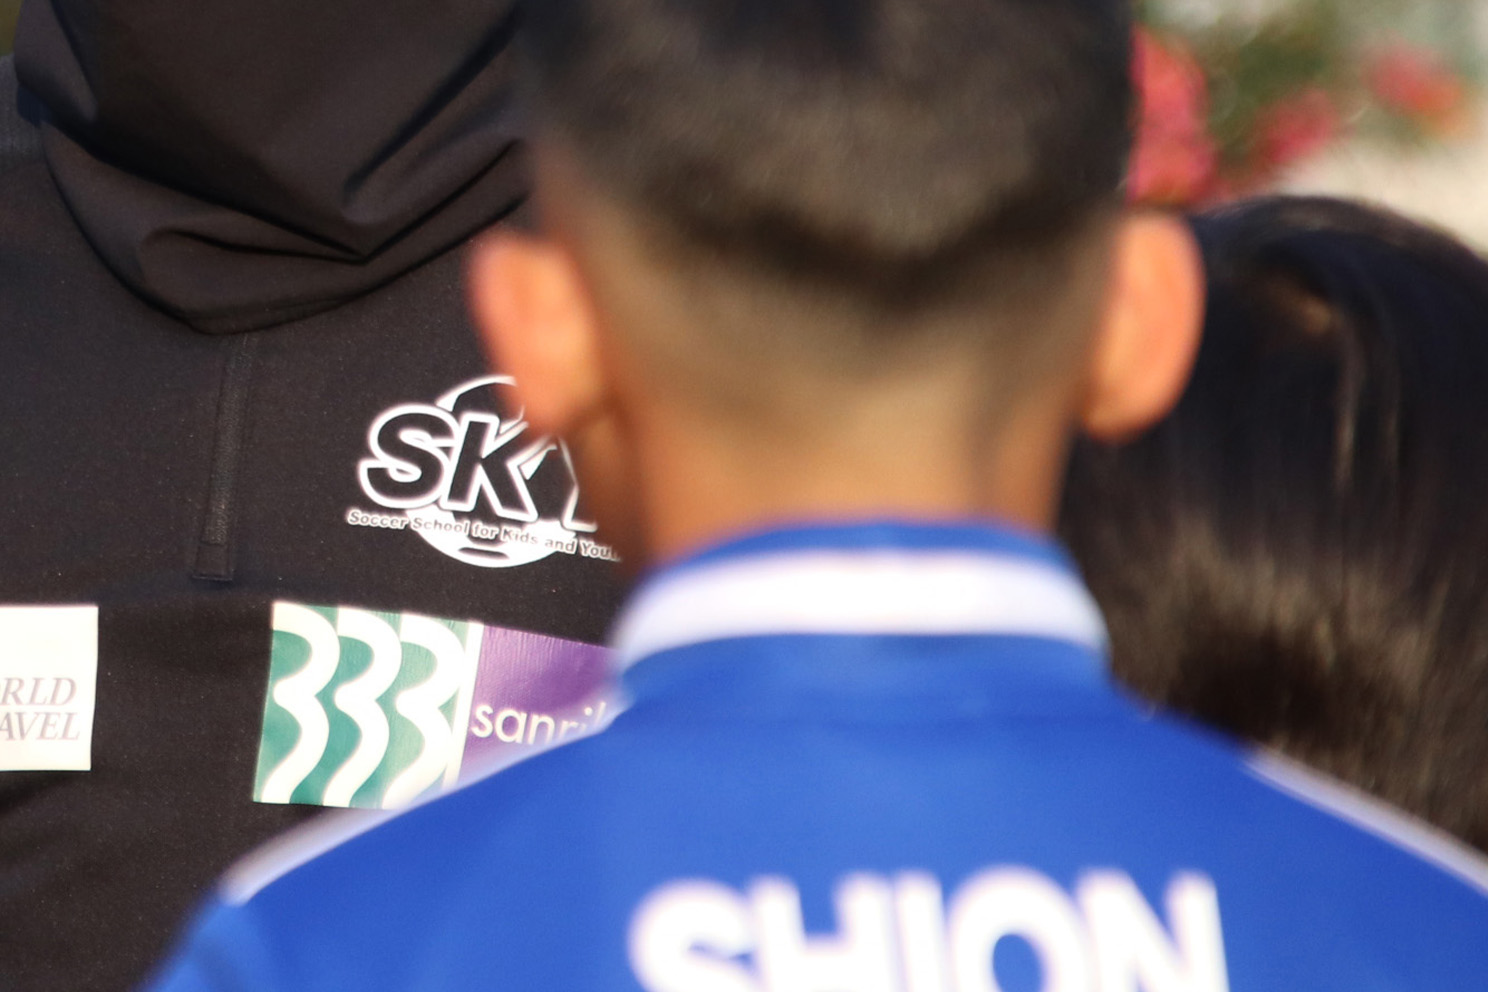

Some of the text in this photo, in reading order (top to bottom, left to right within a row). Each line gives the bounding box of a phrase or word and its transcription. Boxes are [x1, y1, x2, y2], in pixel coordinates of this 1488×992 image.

[348, 509, 620, 561] Soccer School for Kids and You
